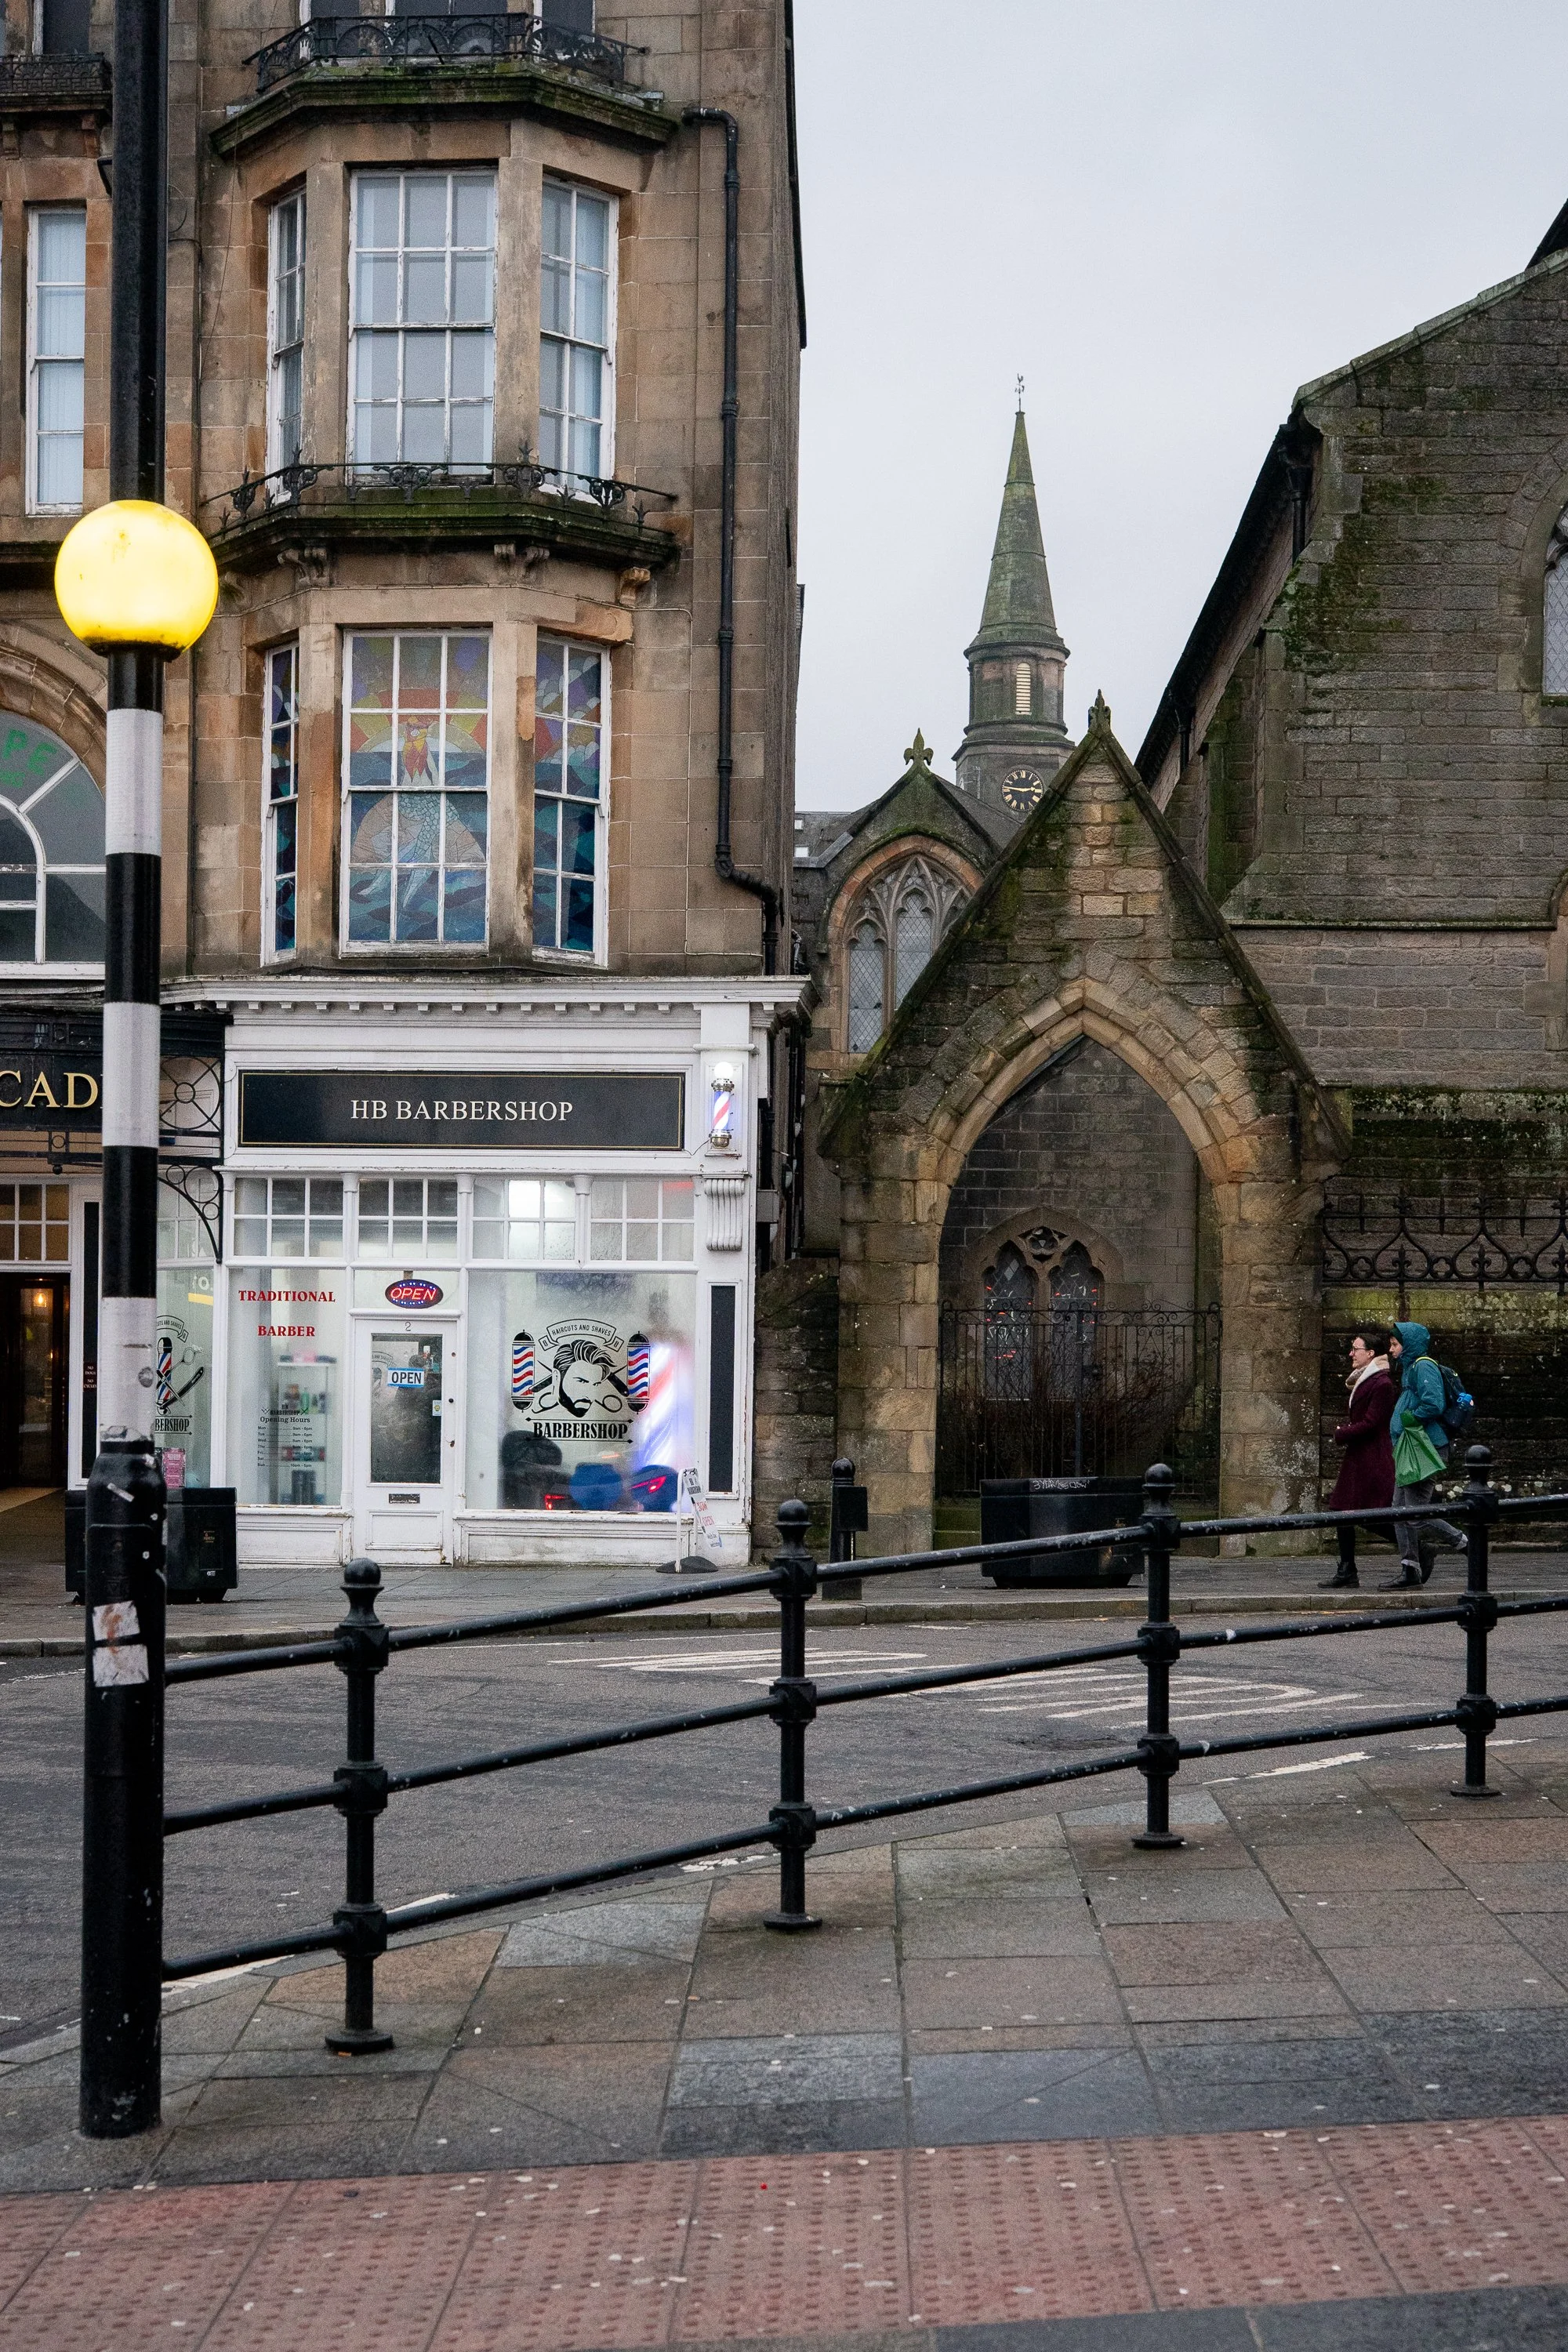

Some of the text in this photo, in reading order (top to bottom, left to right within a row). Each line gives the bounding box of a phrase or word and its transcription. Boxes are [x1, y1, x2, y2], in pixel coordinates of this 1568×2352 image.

[351, 1100, 573, 1121] HB BARBERSHOP
[238, 1290, 336, 1302] TRADITIONAL
[390, 1287, 437, 1301] OPEN
[257, 1325, 315, 1337] BARBER
[405, 1321, 412, 1332] 2
[551, 1324, 578, 1336] HAIRCUTS
[591, 1325, 612, 1337] SHAVES
[391, 1371, 422, 1385] OPEN
[533, 1421, 628, 1439] BARBERSHOP
